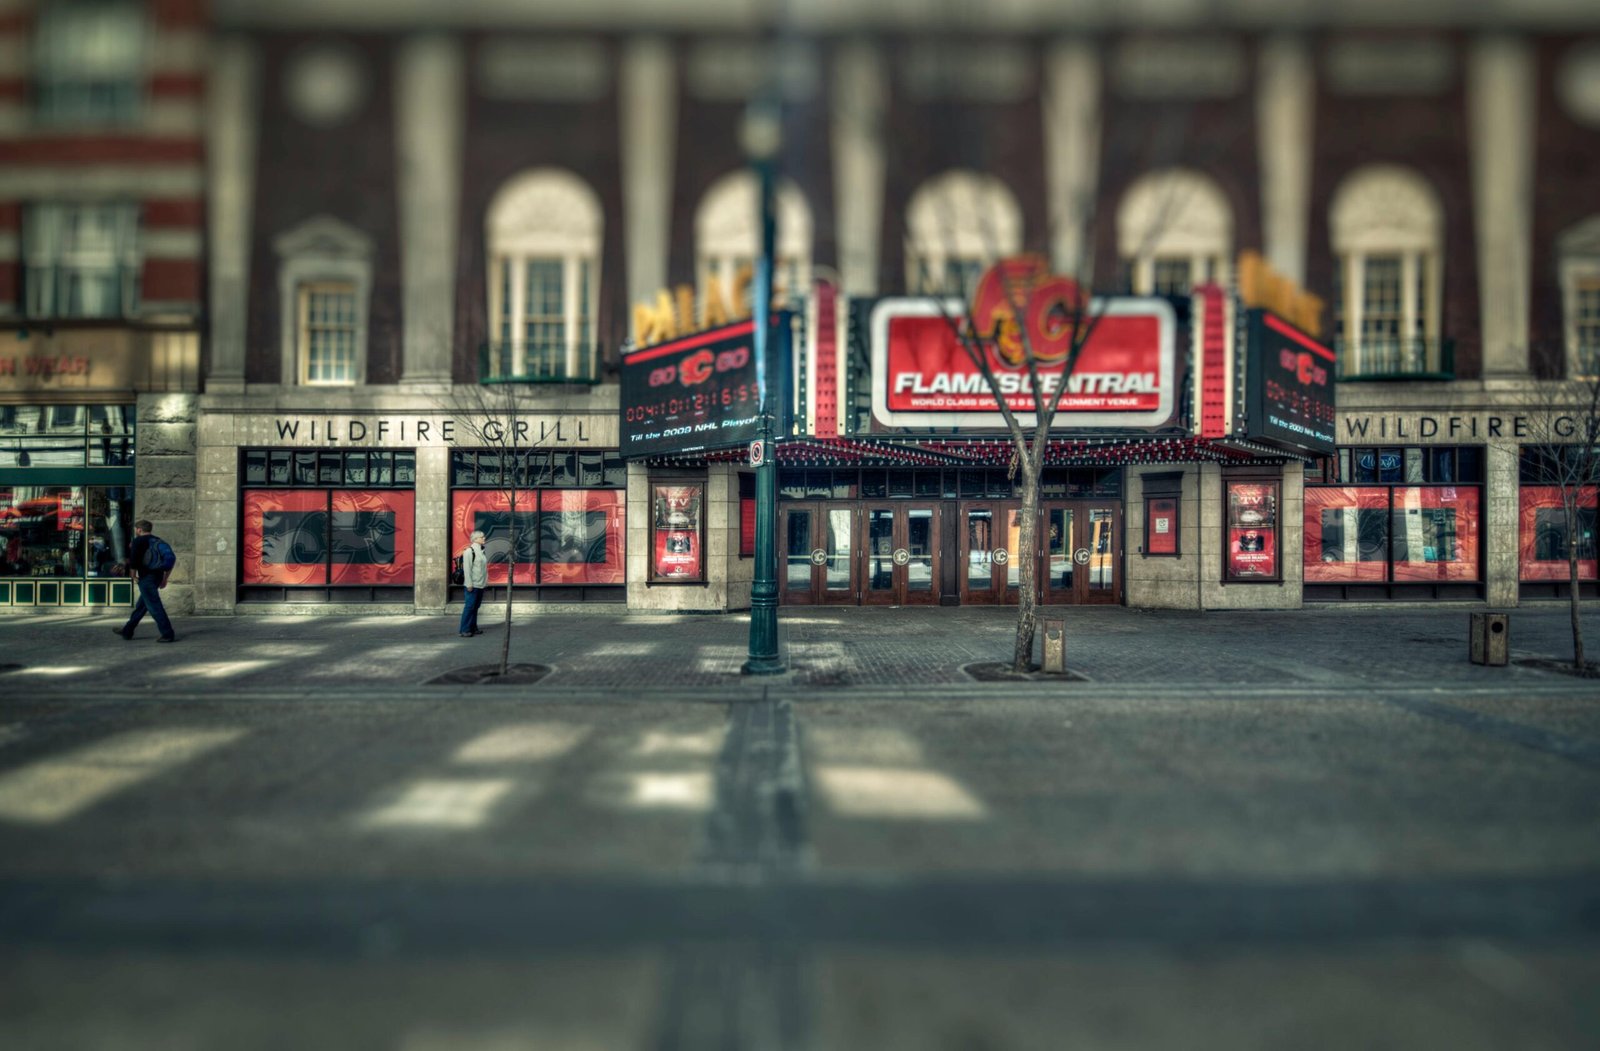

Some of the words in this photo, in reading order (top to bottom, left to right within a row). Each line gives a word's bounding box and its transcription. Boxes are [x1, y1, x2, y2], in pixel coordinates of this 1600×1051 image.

[23, 357, 89, 375] WEAR
[911, 398, 944, 406] WORLD
[946, 398, 976, 406] CLASS
[979, 398, 1016, 406] SPOTS
[1107, 397, 1138, 406] VENUE
[276, 420, 455, 441] WILDFIRE
[483, 420, 590, 442] GRILL
[630, 434, 643, 442] Till
[645, 432, 660, 440] the
[694, 423, 718, 432] NHL
[1346, 417, 1527, 438] WILDFIRE
[1240, 496, 1262, 504] TV
